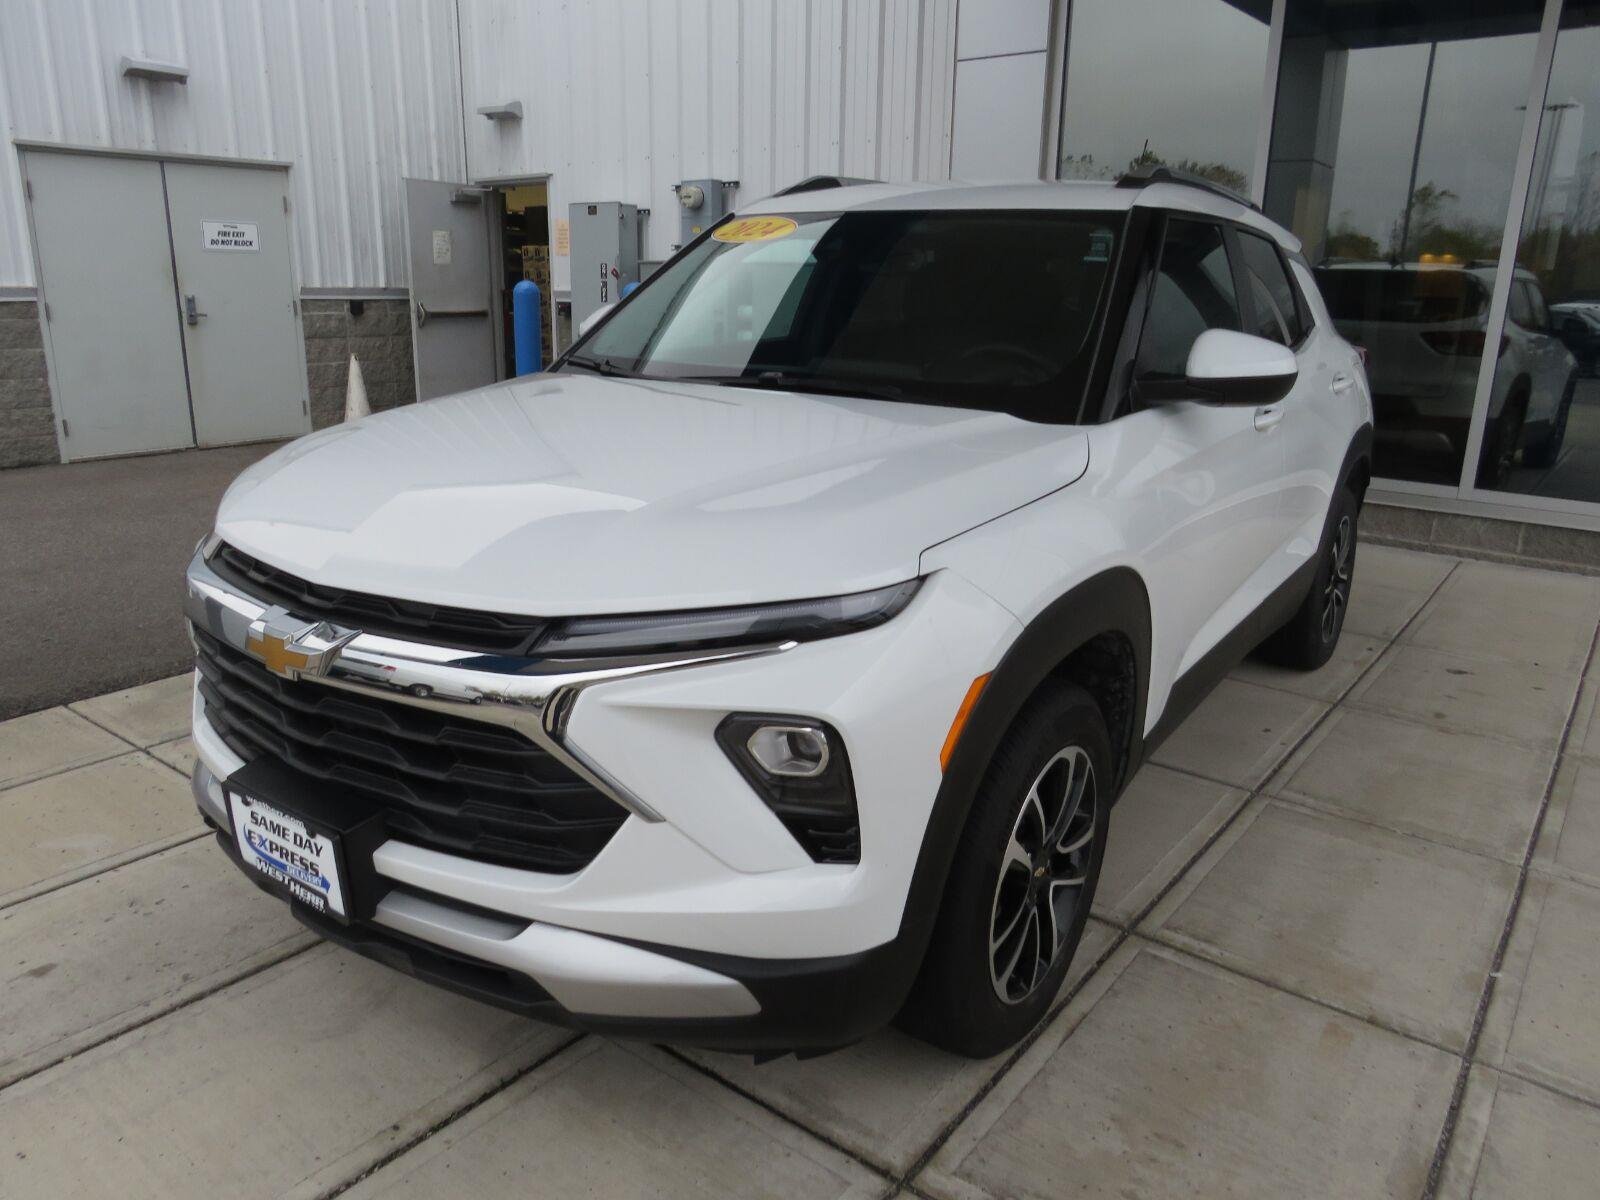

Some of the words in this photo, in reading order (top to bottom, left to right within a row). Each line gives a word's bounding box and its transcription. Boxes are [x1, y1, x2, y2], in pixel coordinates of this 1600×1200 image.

[217, 230, 231, 238] FIRE
[247, 829, 320, 877] EXPRESS
[250, 810, 290, 842] SAME
[293, 832, 323, 858] DAY
